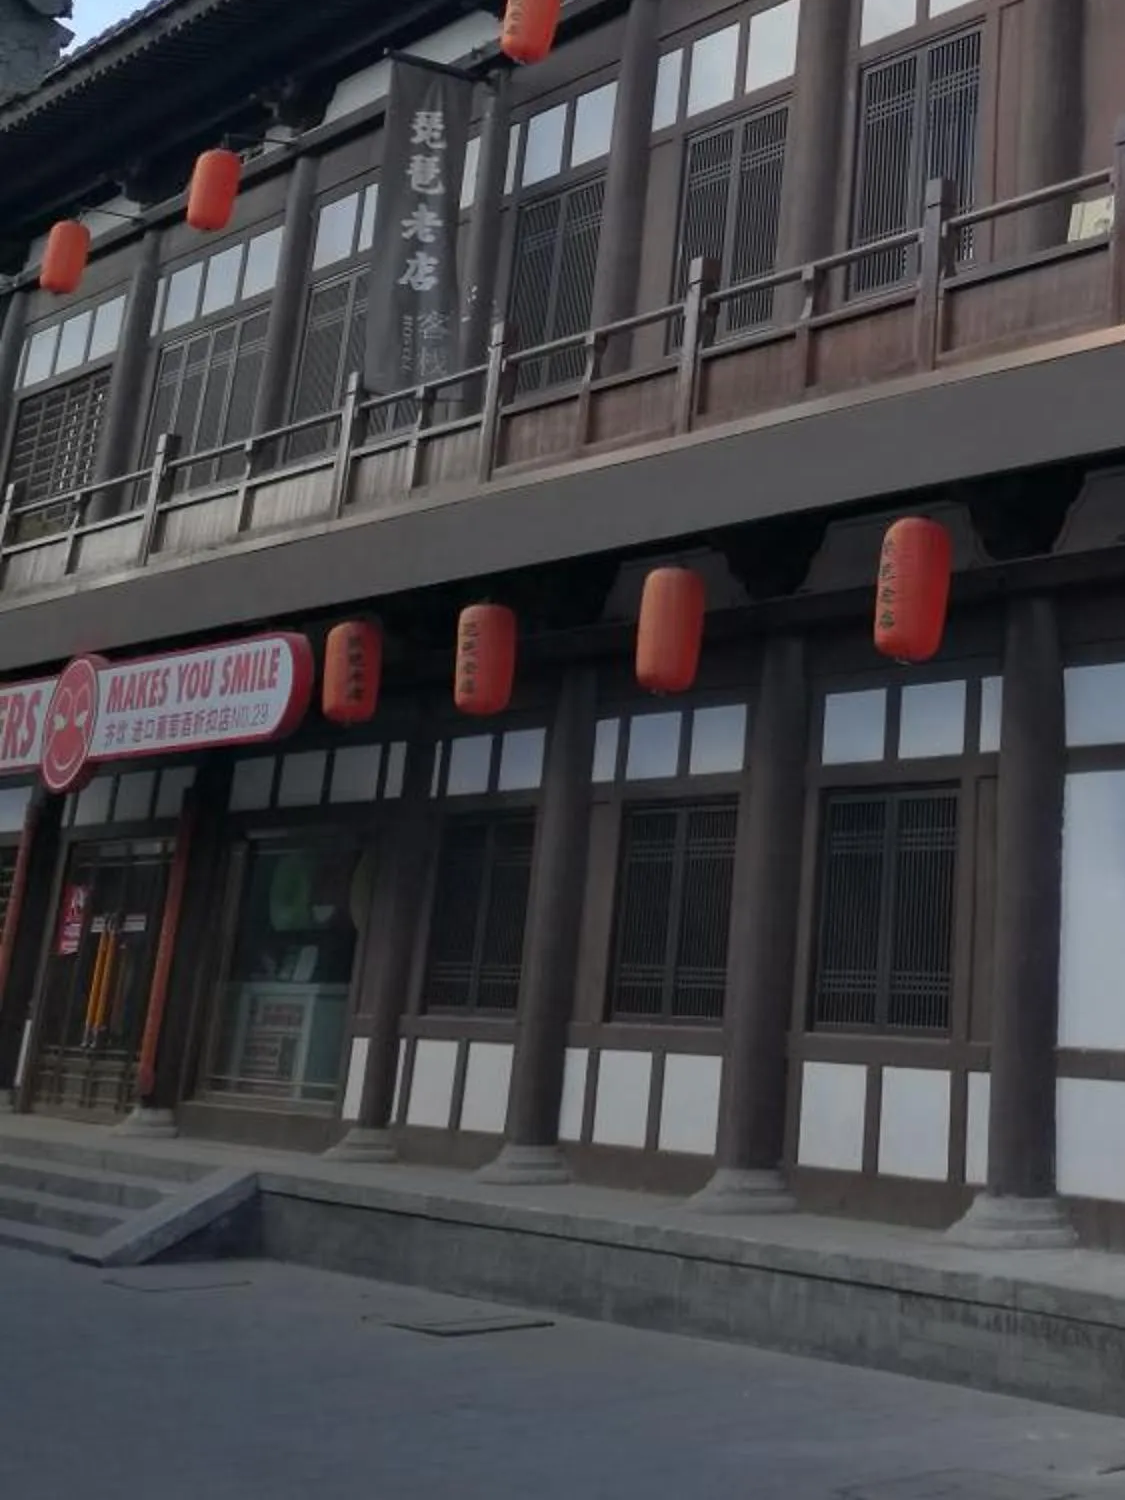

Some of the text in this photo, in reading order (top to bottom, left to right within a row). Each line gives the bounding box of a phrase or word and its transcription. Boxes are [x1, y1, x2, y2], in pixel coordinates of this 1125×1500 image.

[399, 111, 447, 291] 琵琶老店
[106, 645, 281, 714] MAKES YOU SMILE
